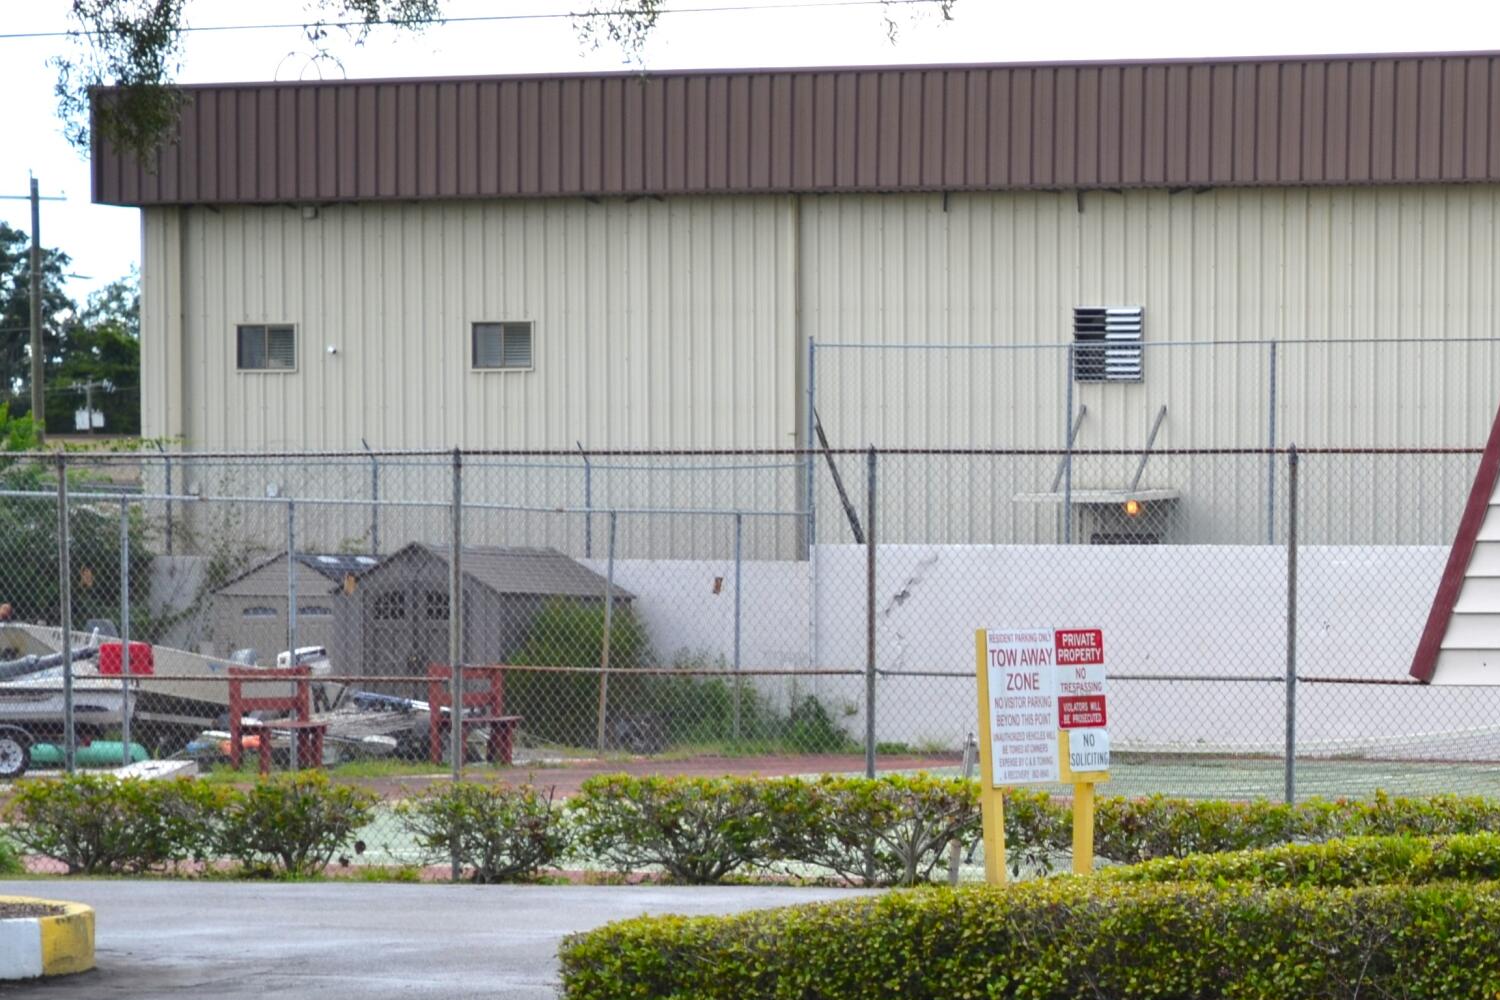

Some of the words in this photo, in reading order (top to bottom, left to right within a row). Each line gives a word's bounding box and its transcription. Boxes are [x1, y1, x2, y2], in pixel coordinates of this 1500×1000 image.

[1015, 632, 1037, 643] PARKING
[1038, 632, 1052, 642] ONLY
[1062, 632, 1096, 647] PRIVATE
[989, 648, 1018, 667] TOW
[1020, 647, 1053, 666] AWAY
[1058, 648, 1101, 662] PROPERTY
[1075, 666, 1087, 680] NO
[1006, 672, 1041, 691] ZONE
[1060, 681, 1103, 693] TRESPASSING
[994, 697, 1004, 709] NO
[1004, 696, 1027, 709] VISITOR
[1028, 696, 1052, 708] PARKING
[1063, 702, 1089, 713] VIOLATORS
[1089, 701, 1102, 712] WILL
[996, 714, 1020, 727] BEYOND
[1021, 713, 1034, 726] THIS
[1035, 712, 1051, 725] POINT
[1083, 734, 1095, 747] NO
[1071, 751, 1109, 767] SOLICITING
